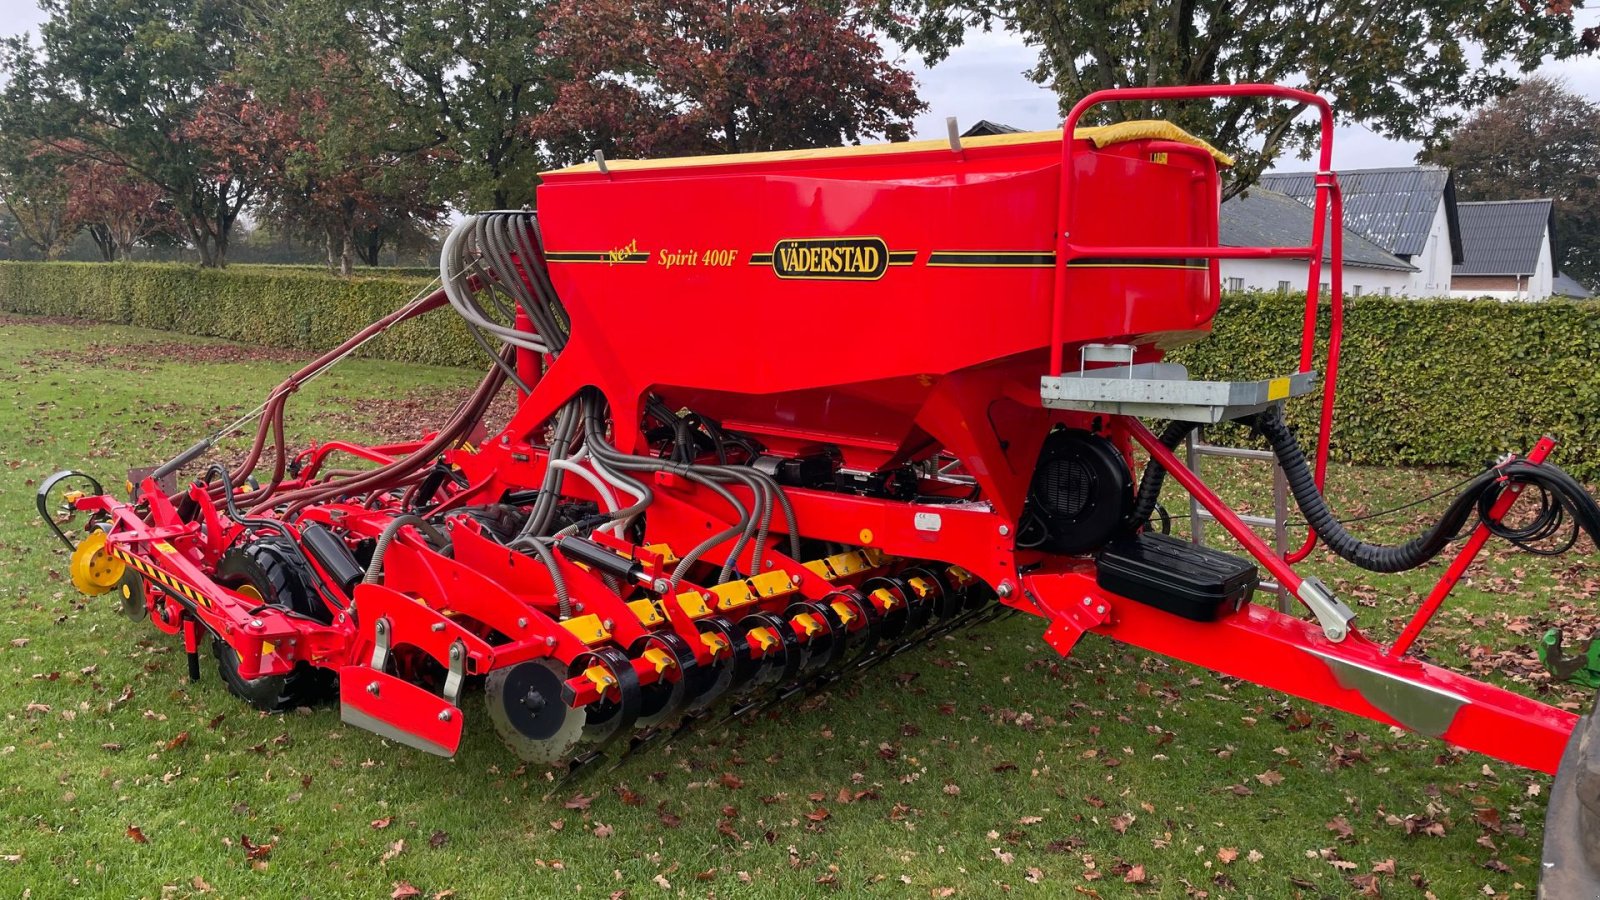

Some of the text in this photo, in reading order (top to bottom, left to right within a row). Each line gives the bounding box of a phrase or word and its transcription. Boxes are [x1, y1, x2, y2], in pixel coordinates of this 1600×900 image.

[609, 238, 637, 267] Next
[658, 248, 738, 270] Spirit 400F
[779, 242, 879, 272] VÄDERSTAD
